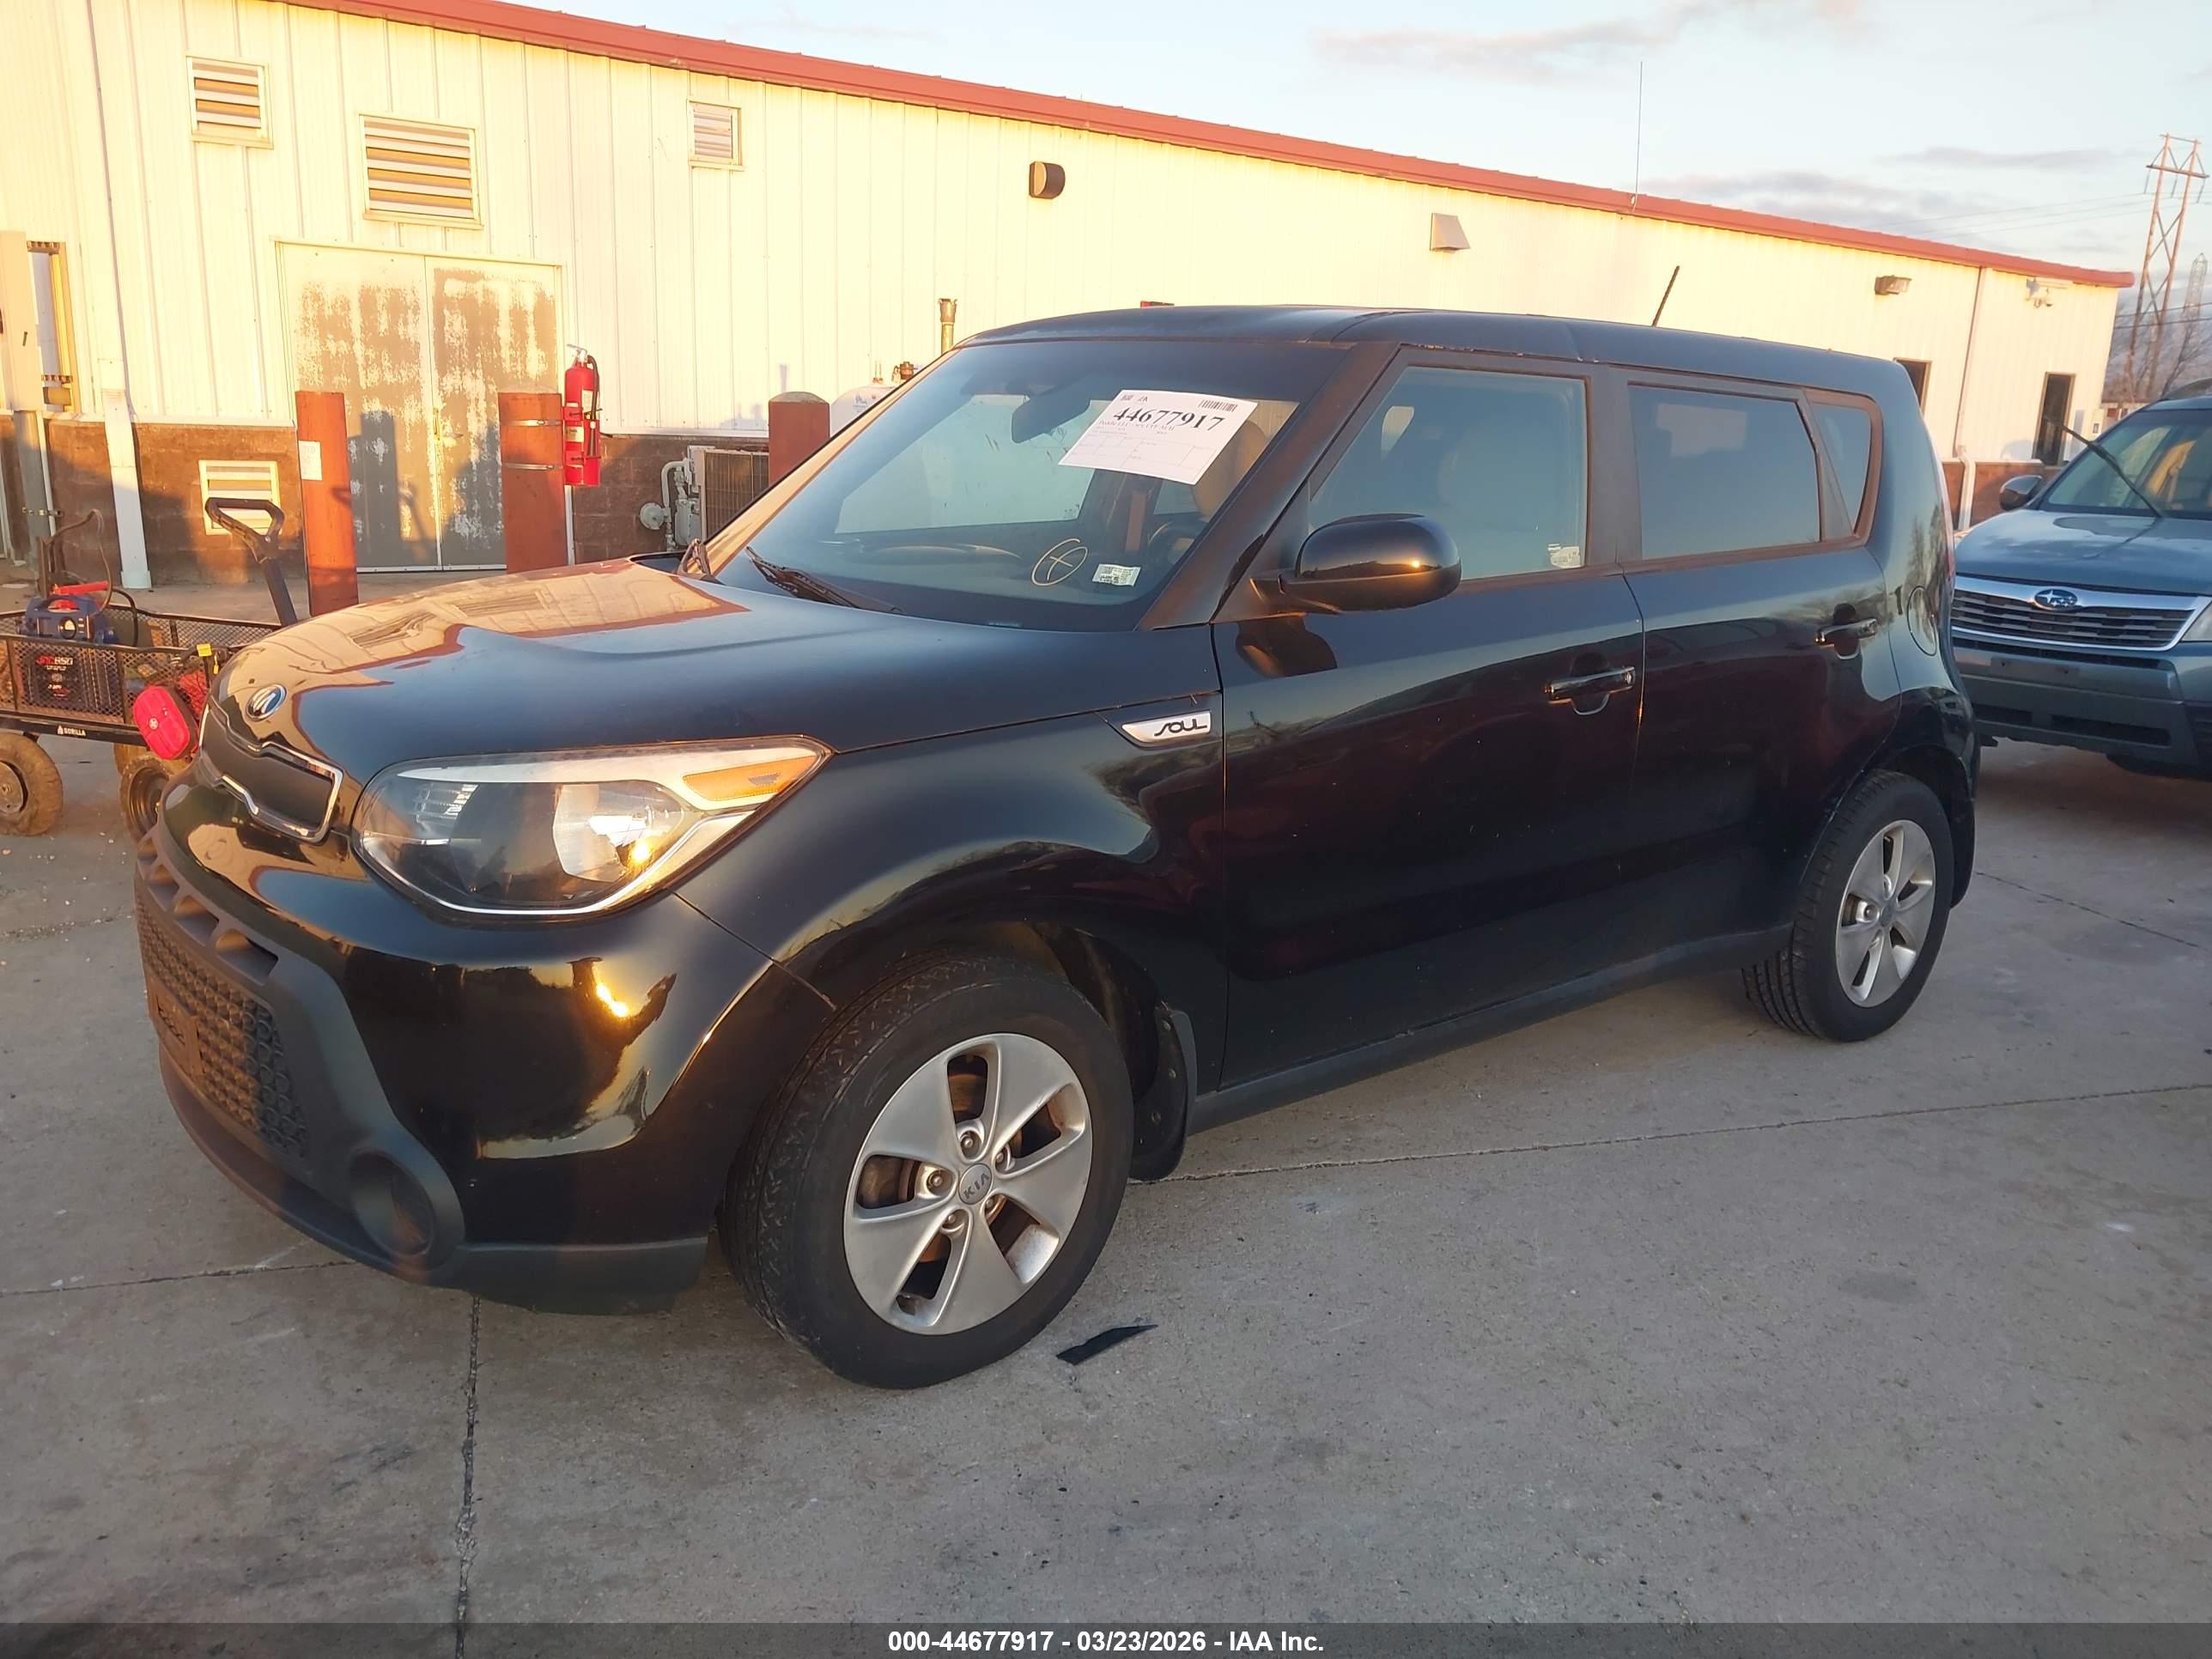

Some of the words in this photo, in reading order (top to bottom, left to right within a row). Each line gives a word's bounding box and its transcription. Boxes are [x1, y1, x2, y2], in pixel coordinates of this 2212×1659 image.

[1113, 407, 1225, 431] 44677917
[64, 727, 86, 736] GORILLA
[1154, 718, 1207, 737] SOUL
[963, 1173, 989, 1199] KIA
